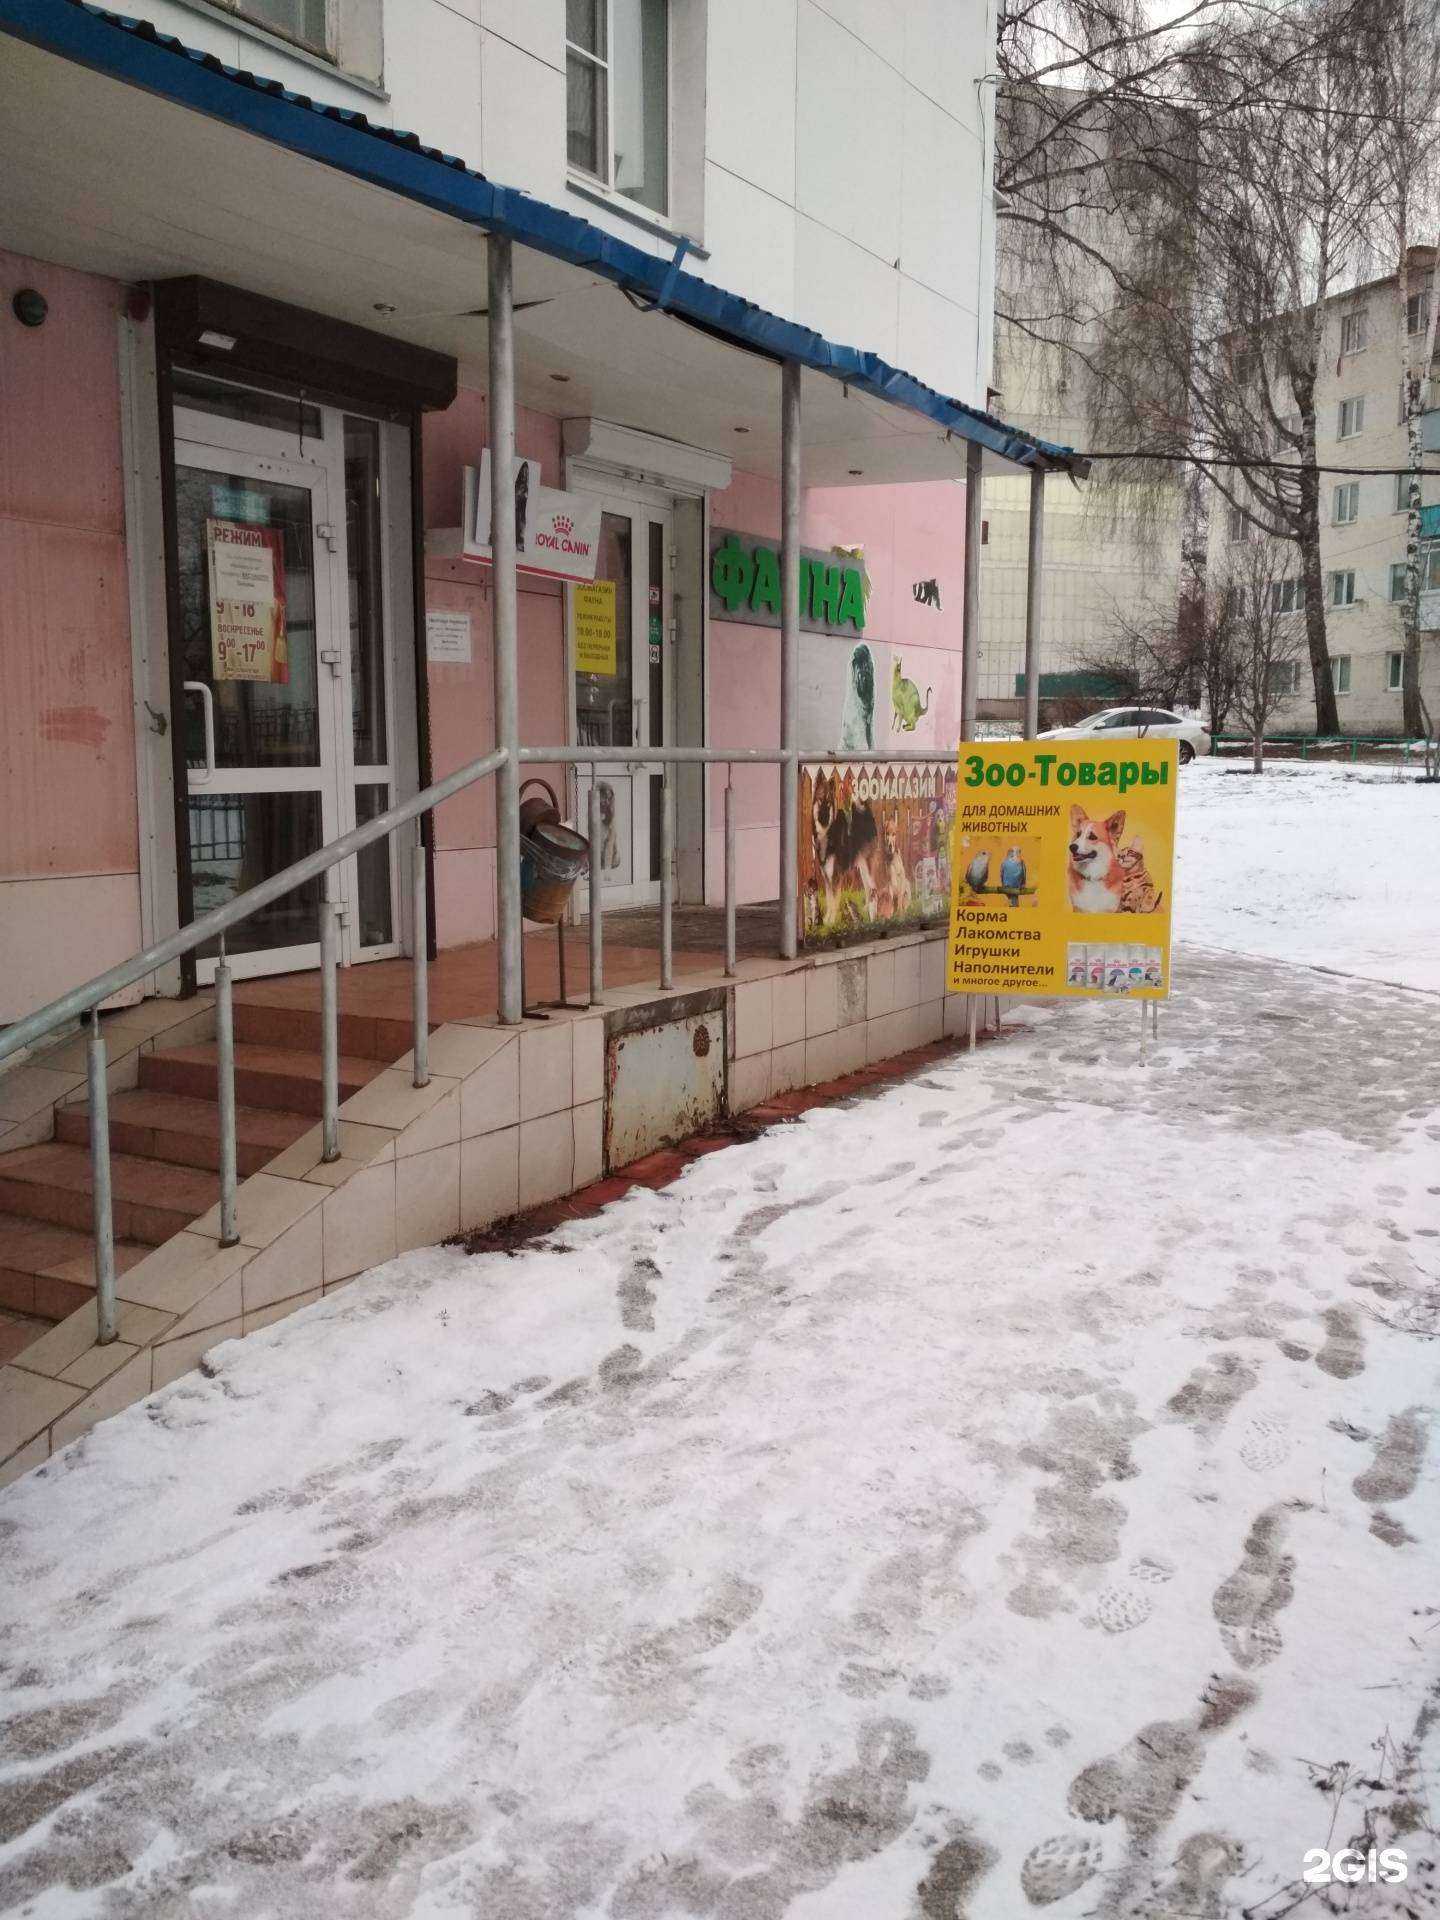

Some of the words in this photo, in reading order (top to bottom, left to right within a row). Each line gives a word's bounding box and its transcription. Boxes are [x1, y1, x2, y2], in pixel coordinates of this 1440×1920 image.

[214, 527, 262, 547] РЕЖИМ
[562, 539, 590, 555] CANIN
[217, 624, 264, 636] ВОСКРЕСЕНЬЕ
[964, 754, 1169, 793] Зоо-Товары
[852, 777, 936, 801] ЗООМАГАЗИН
[962, 805, 986, 818] ДЛЯ
[988, 805, 1061, 818] ДОМАШНИХ
[961, 821, 1028, 833] ЖИВОТНЫХ
[956, 909, 1008, 925] Корма
[955, 927, 1041, 942] Лакомства
[954, 945, 1021, 961] Игрушки
[953, 961, 1055, 976] Наполнители
[953, 977, 960, 985] и
[962, 978, 1000, 986] многое
